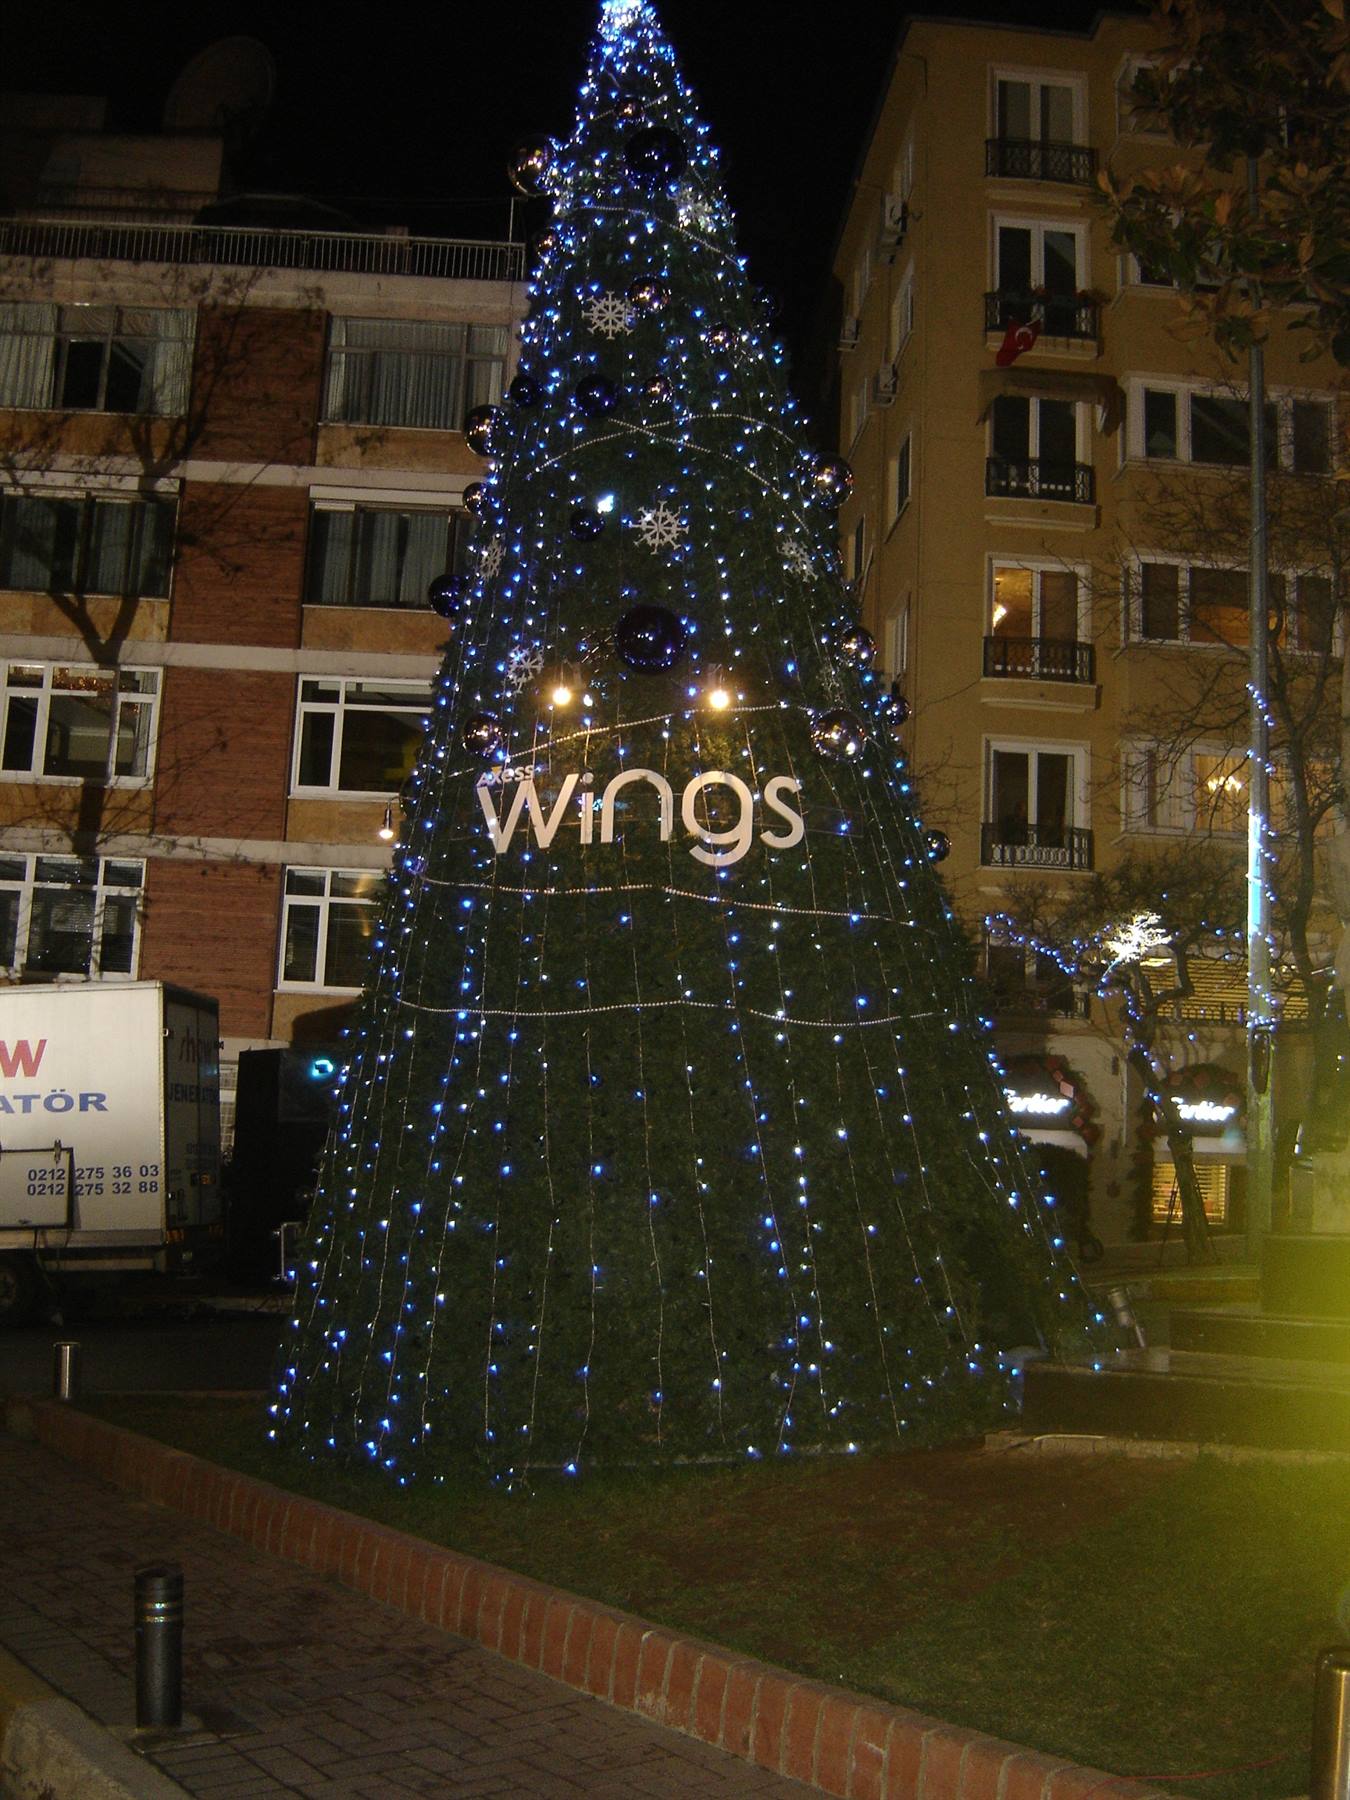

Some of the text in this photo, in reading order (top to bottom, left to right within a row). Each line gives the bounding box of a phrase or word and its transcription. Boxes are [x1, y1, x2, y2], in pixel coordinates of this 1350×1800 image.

[28, 1168, 66, 1181] 0212
[75, 1167, 104, 1180] 275
[112, 1166, 132, 1178] 36
[139, 1165, 159, 1177] 03
[27, 1181, 158, 1196] 0212 275 32 88
